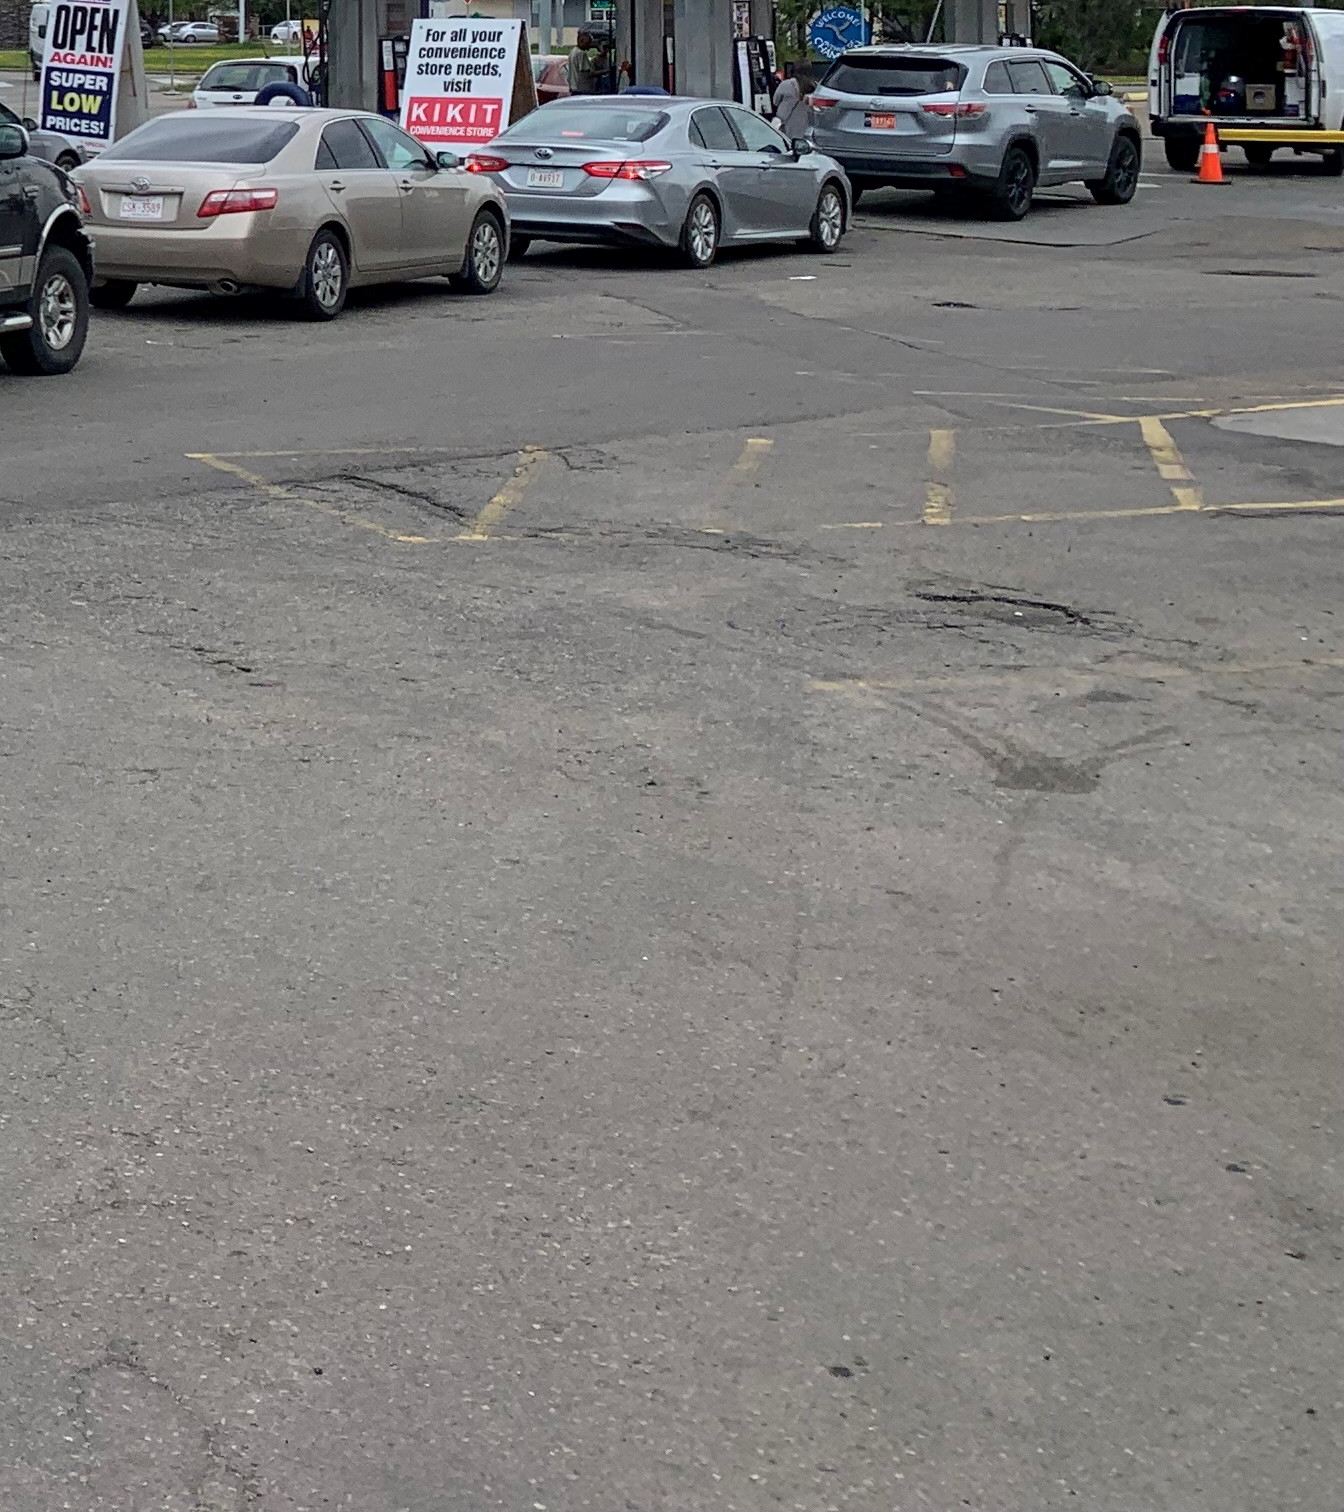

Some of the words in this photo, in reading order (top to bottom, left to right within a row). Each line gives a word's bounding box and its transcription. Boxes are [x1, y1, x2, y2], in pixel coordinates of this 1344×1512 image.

[52, 4, 120, 55] OPEN
[425, 29, 446, 42] For
[450, 29, 467, 42] all
[470, 29, 503, 44] your
[49, 51, 114, 68] AGAIN!
[418, 45, 506, 60] convenience
[416, 62, 452, 76] store
[456, 62, 502, 78] needs,
[49, 71, 109, 91] SUPER
[443, 78, 472, 93] visit
[50, 90, 103, 115] LOW
[410, 102, 499, 124] KIKIT
[45, 115, 105, 136] PRICES!
[409, 125, 465, 137] CONVENIENCE
[466, 126, 495, 137] STORE
